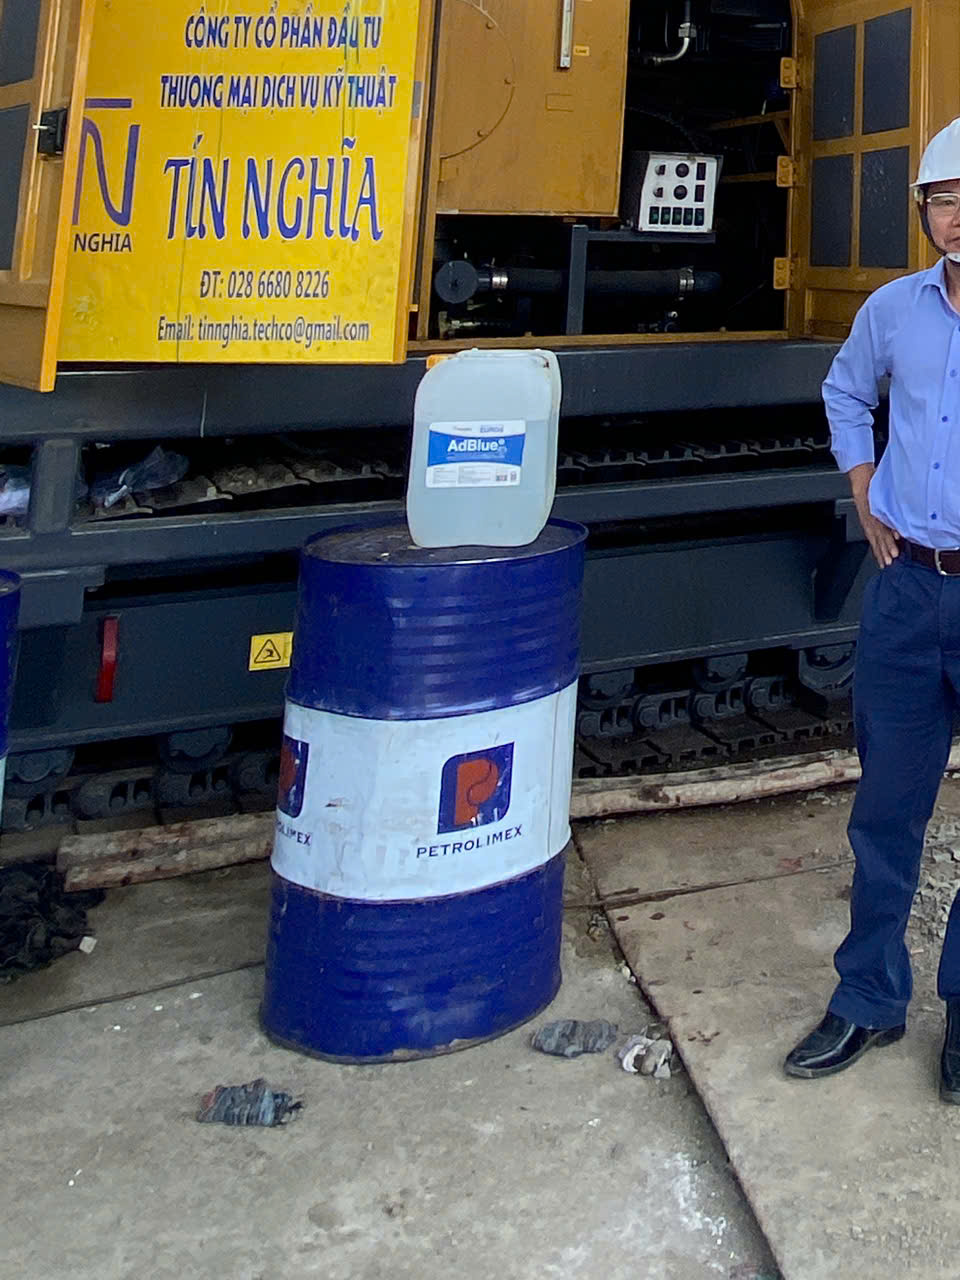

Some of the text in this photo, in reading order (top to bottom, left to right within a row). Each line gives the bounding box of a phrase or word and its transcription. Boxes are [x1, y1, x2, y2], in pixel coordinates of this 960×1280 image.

[185, 6, 230, 48] CÔNG
[234, 16, 252, 48] TY
[255, 0, 277, 48] CỔ
[227, 75, 258, 115] MẠI
[261, 75, 296, 115] DỊCH
[300, 75, 320, 115] VỤ
[322, 67, 344, 108] KỸ
[348, 66, 397, 116] THUẬT
[164, 134, 384, 241] TÍN NGHĨA
[73, 233, 132, 253] NGHIA
[200, 270, 330, 298] ĐT: 028 6680 8226
[157, 316, 369, 349] Email: tinnghia.techco@gmail.com
[447, 439, 499, 452] AdBlue
[416, 824, 523, 858] PETROLIMEX
